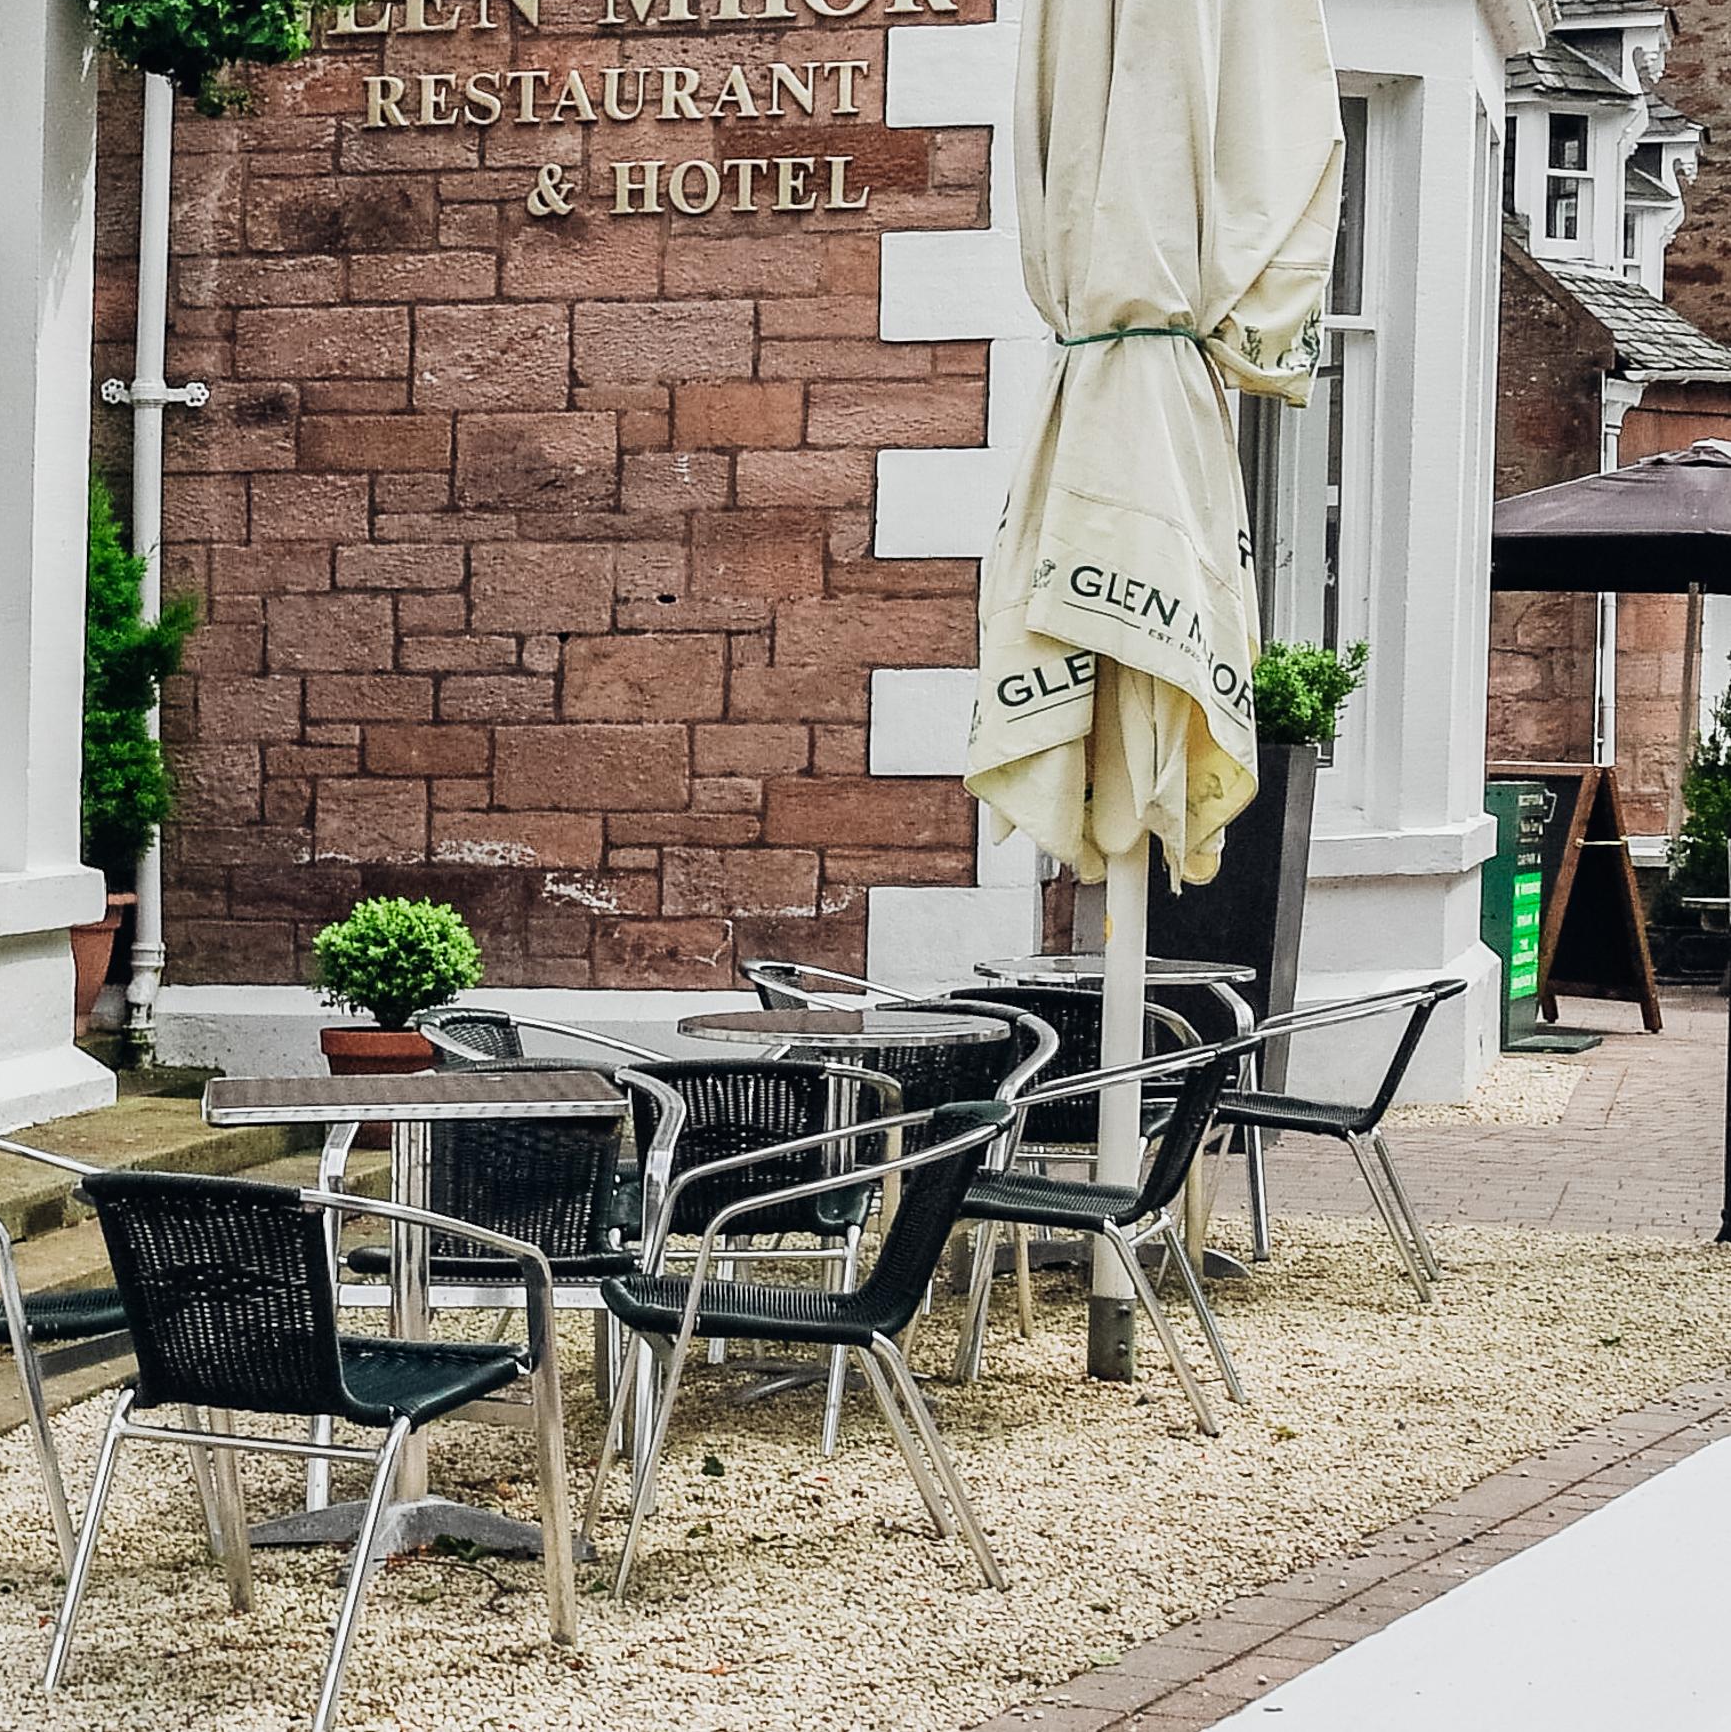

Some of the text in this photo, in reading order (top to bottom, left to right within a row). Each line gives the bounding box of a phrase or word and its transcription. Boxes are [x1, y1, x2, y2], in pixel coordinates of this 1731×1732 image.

[363, 60, 869, 129] RESTAURANT
[526, 156, 870, 217] & HOTEL
[1070, 565, 1180, 627] GLEN
